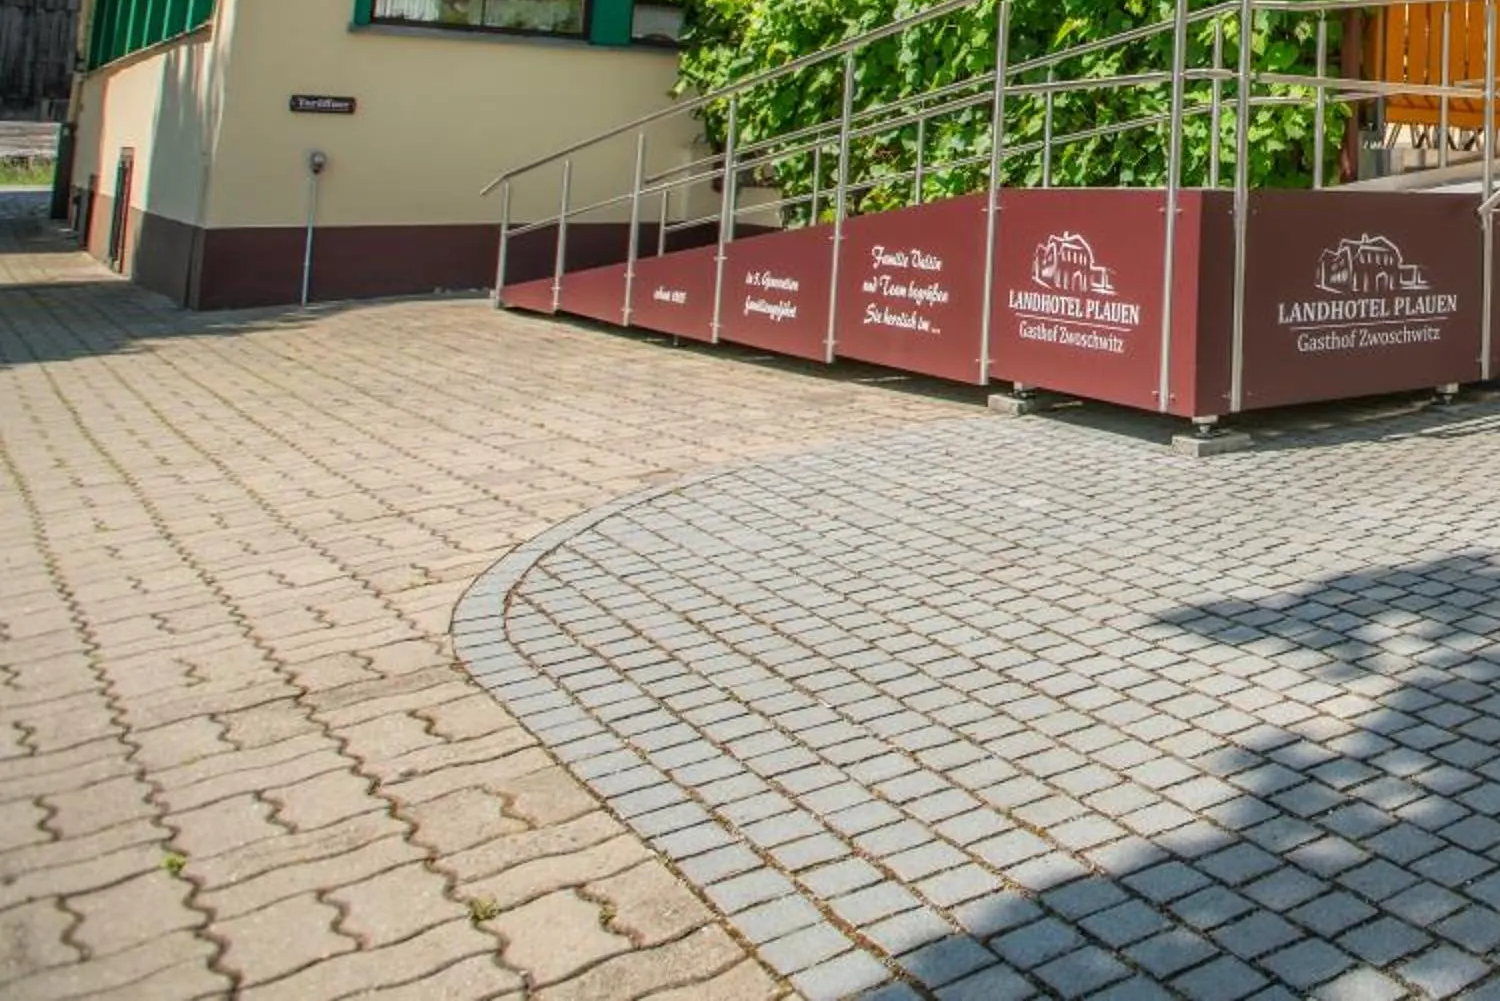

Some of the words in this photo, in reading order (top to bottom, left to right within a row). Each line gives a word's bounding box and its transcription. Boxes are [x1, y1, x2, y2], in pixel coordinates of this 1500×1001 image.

[879, 275, 907, 297] Team
[1008, 289, 1083, 317] LANDHOTEL
[1085, 299, 1140, 325] PLAUEN
[1278, 298, 1389, 324] LANDHOTEL
[1394, 294, 1457, 316] PLAUEN
[1019, 320, 1058, 342] Gasthof
[1059, 326, 1124, 353] Zwoschwitz
[1297, 328, 1357, 352] Gasthof
[1358, 323, 1441, 348] Zwoschwitz
